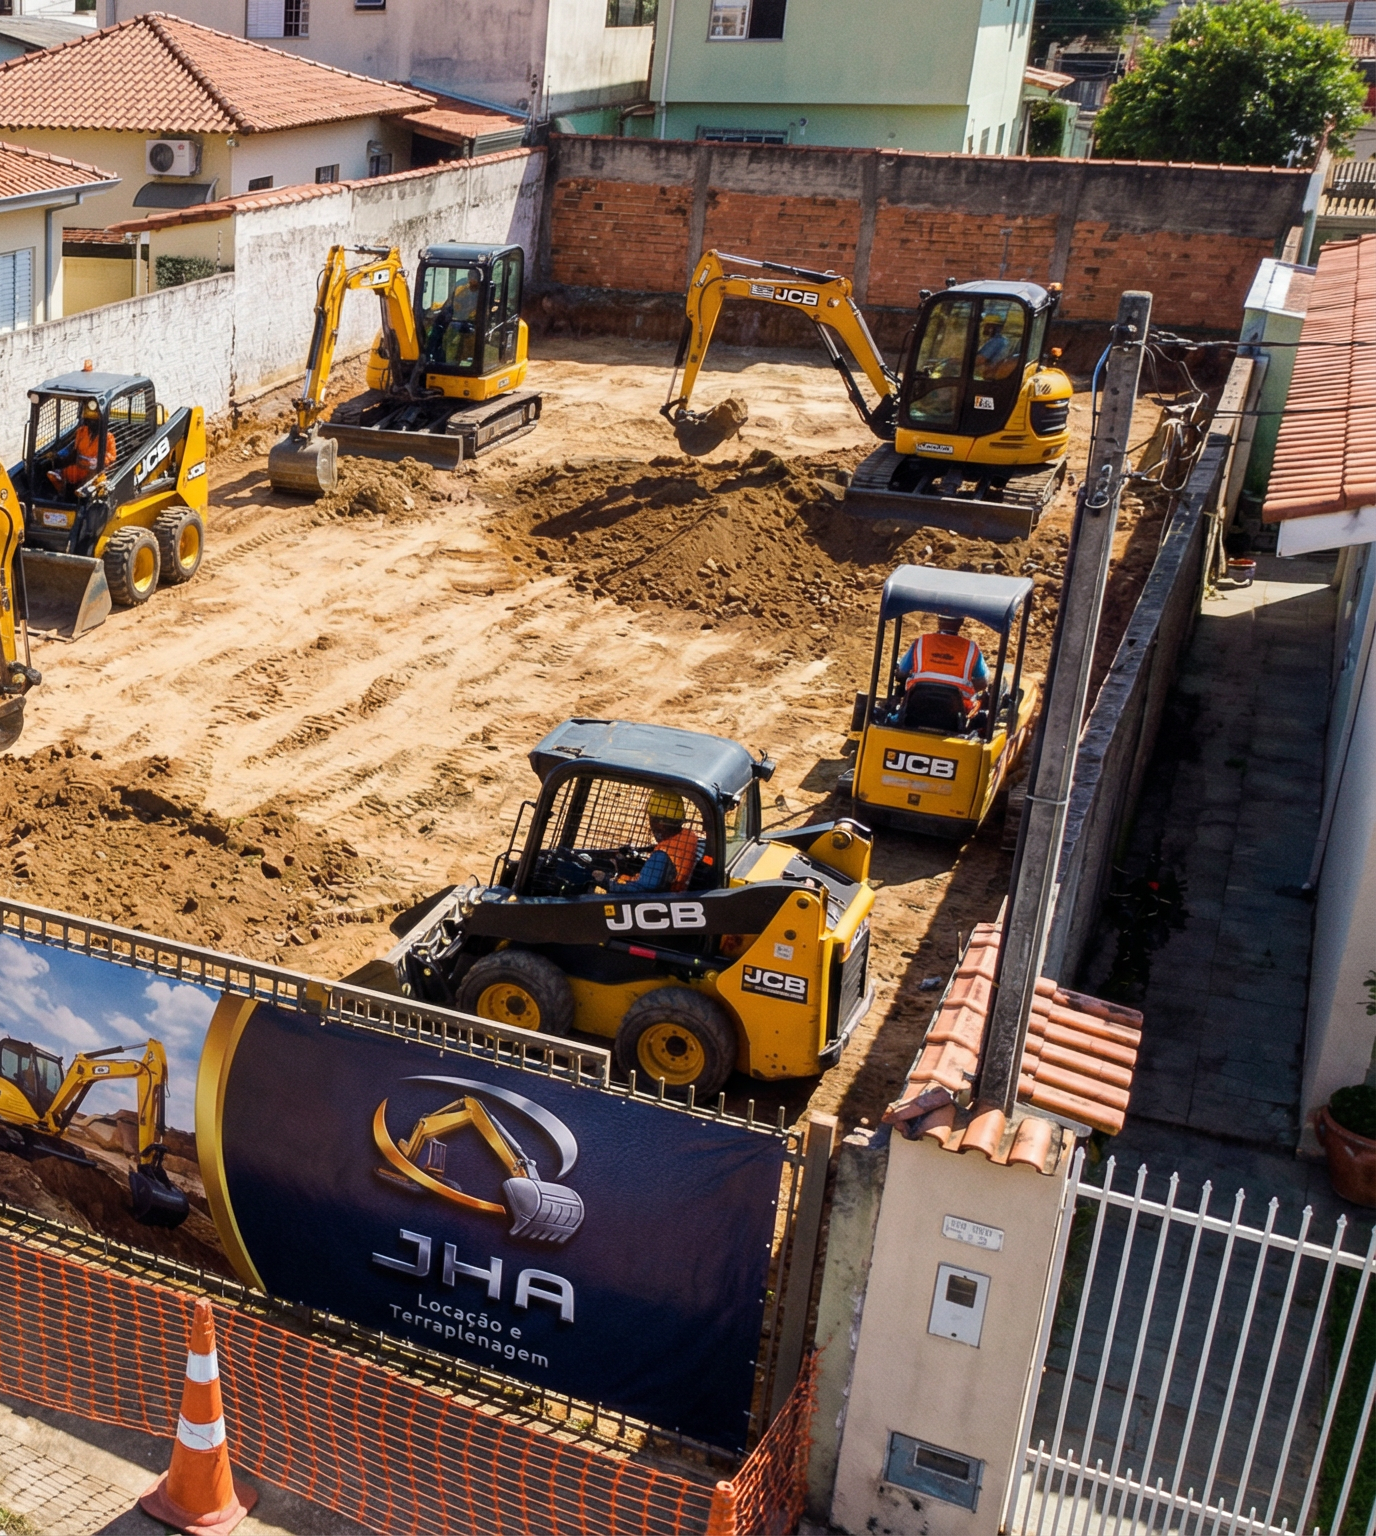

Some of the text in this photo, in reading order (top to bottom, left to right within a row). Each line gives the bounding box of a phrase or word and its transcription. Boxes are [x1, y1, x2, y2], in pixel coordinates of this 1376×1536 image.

[775, 289, 818, 306] JCB
[134, 436, 170, 486] JCB
[885, 753, 954, 778] JCB
[606, 902, 706, 931] JCB
[744, 969, 806, 994] JCB
[372, 1228, 574, 1323] JHA
[418, 1293, 522, 1339] Locação e
[389, 1303, 549, 1368] Terraplenagem
